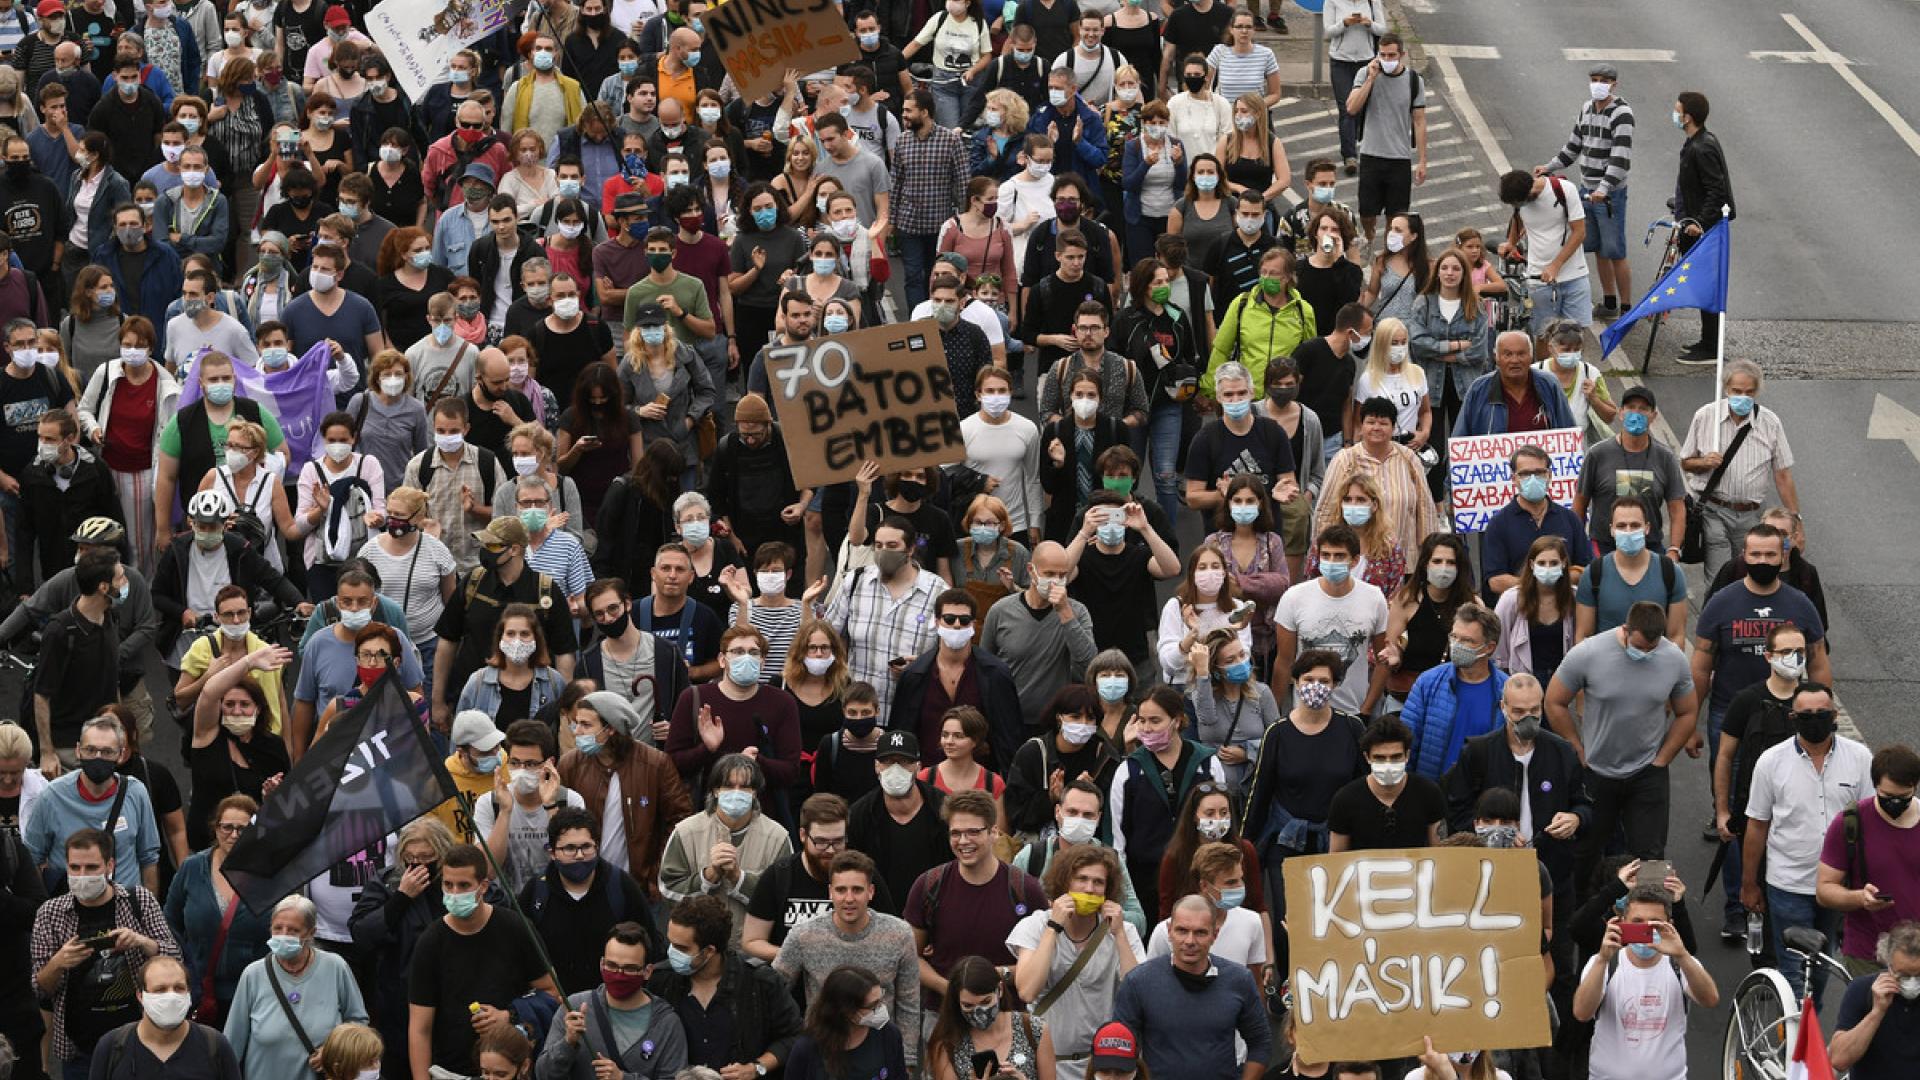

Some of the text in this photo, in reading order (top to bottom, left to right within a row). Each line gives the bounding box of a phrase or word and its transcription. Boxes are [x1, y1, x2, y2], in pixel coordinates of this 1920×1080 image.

[768, 340, 851, 399] 70
[824, 411, 966, 471] EMBER
[1732, 619, 1793, 640] MUST
[1311, 859, 1523, 938] KELL
[1296, 937, 1501, 1025] MÁSIK!
